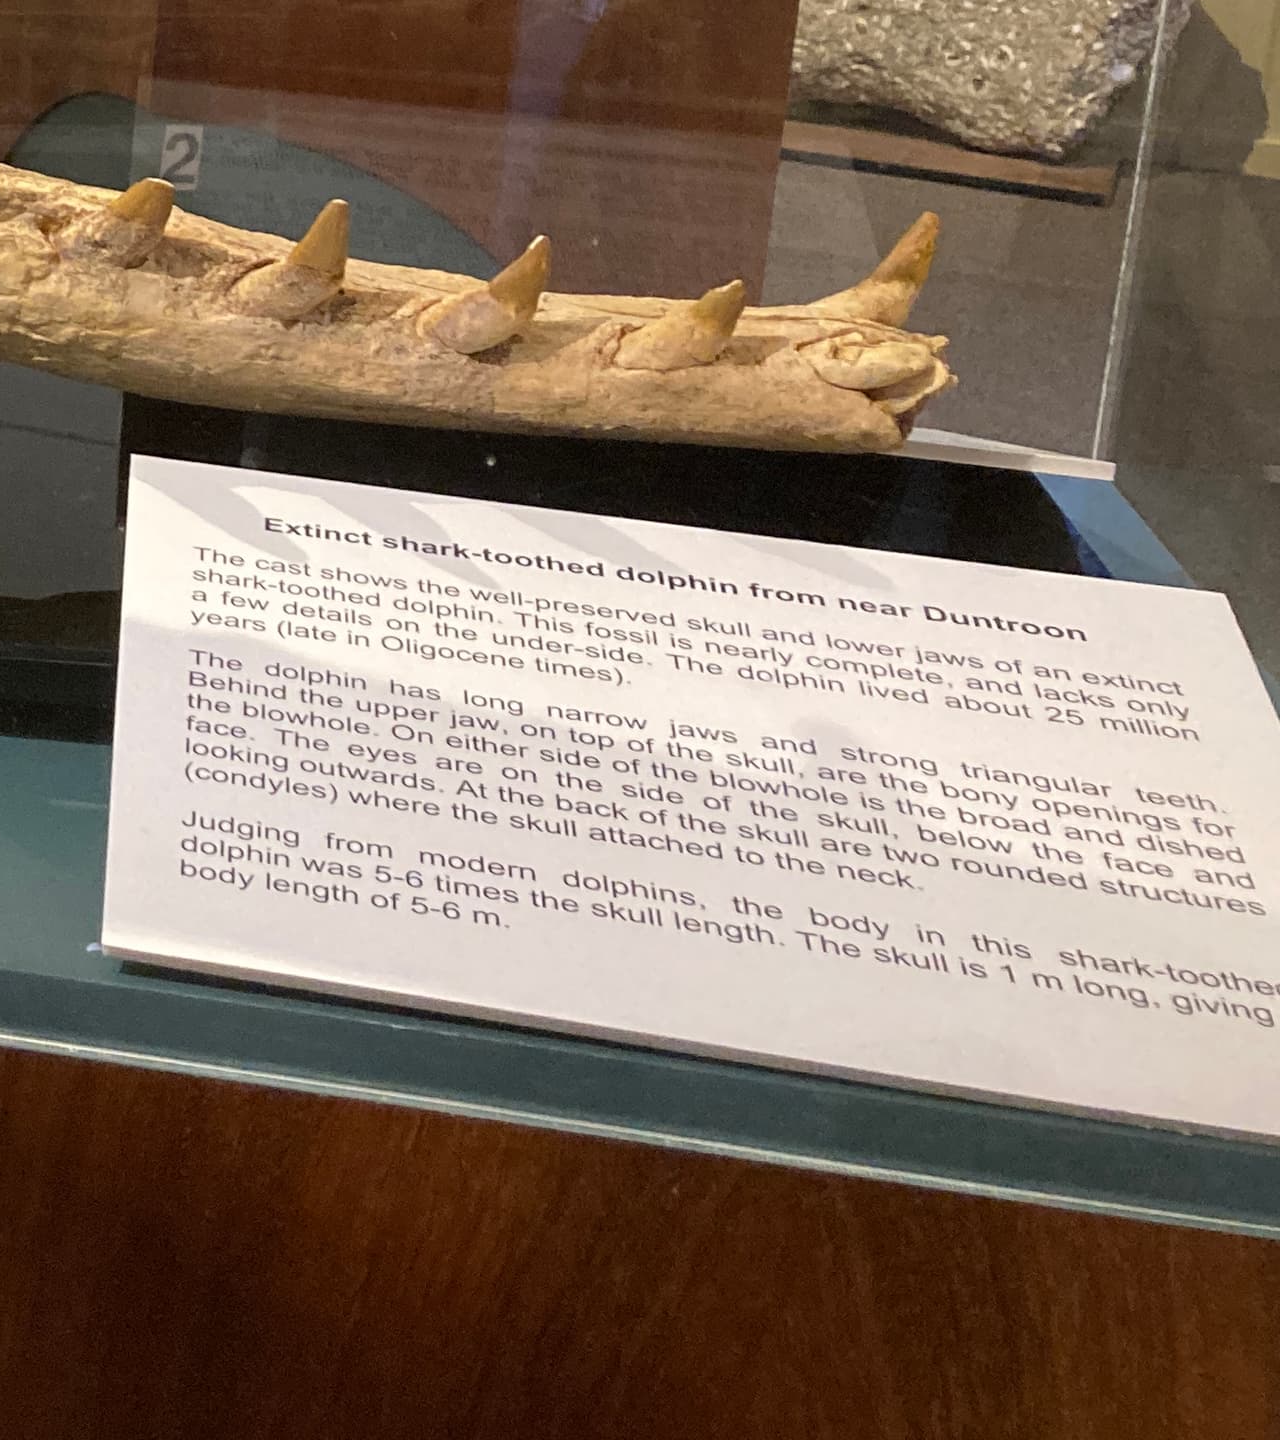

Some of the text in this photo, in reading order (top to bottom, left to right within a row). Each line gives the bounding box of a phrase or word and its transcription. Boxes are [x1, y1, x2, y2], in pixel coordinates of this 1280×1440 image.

[165, 131, 199, 184] 2
[190, 610, 631, 686] years (late in Oligocene times).
[192, 568, 1189, 722] shark-toothed dolphin. This fossil is nearly complete, and lacks only
[193, 545, 1184, 696] The cast shows the well-preserved skull and lower jaws of an extinct
[263, 516, 1088, 642] Extinct shark-toothed dolphin from near Duntroon
[188, 648, 1226, 814] The dolphin has long narrow jaws and strong triangular teeth.
[191, 589, 1200, 741] a few details on the under-side. The dolphin lived about 25 million
[184, 760, 922, 890] (condyles) where the skull attached to the neck.
[185, 714, 1256, 890] face. The eyes are on the side of the skull, below the face and
[188, 669, 1235, 838] Behind the upper jaw, on top of the skull, are the bony openings for
[181, 809, 1280, 996] Judging from modern dolphins, the body in this shark-toothe
